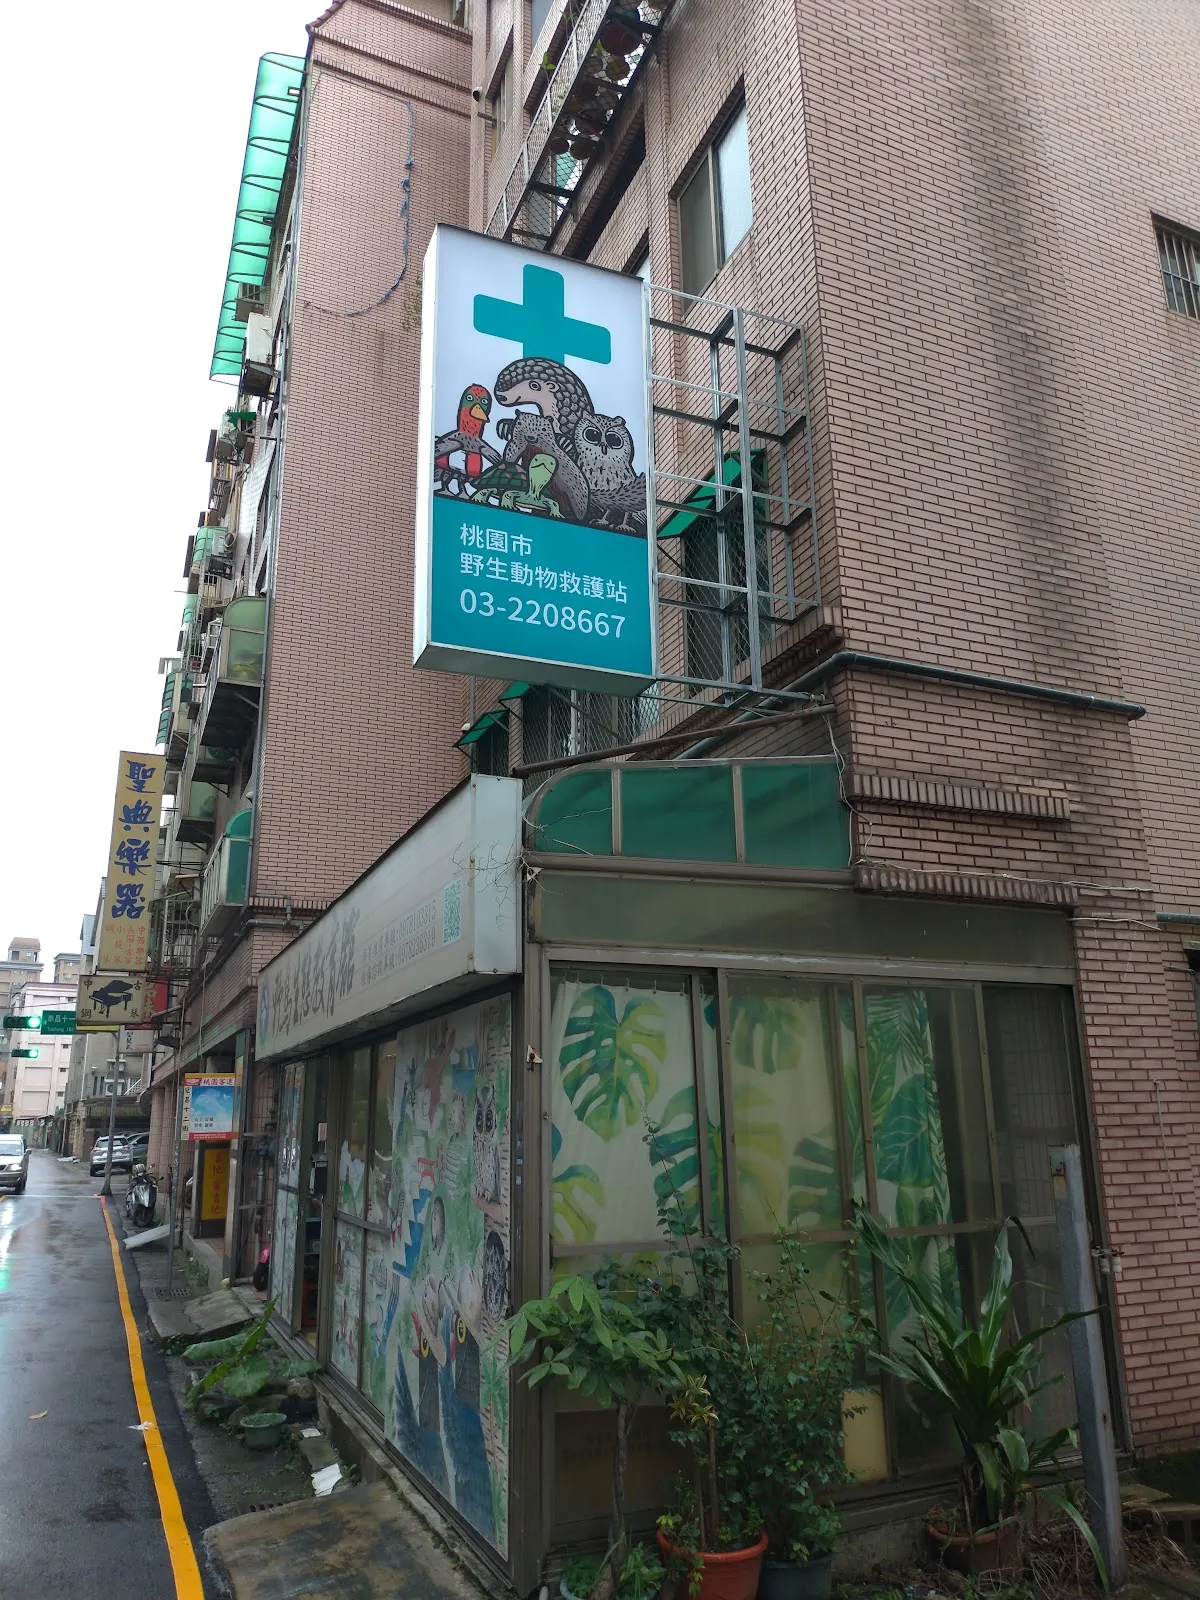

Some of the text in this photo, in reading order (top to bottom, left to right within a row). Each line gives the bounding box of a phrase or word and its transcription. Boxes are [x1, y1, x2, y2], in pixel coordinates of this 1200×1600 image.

[459, 522, 534, 557] 桃園市
[459, 552, 628, 604] 野生動物救護站
[459, 588, 626, 639] 03-2208667
[112, 759, 156, 919] 聖典樂器
